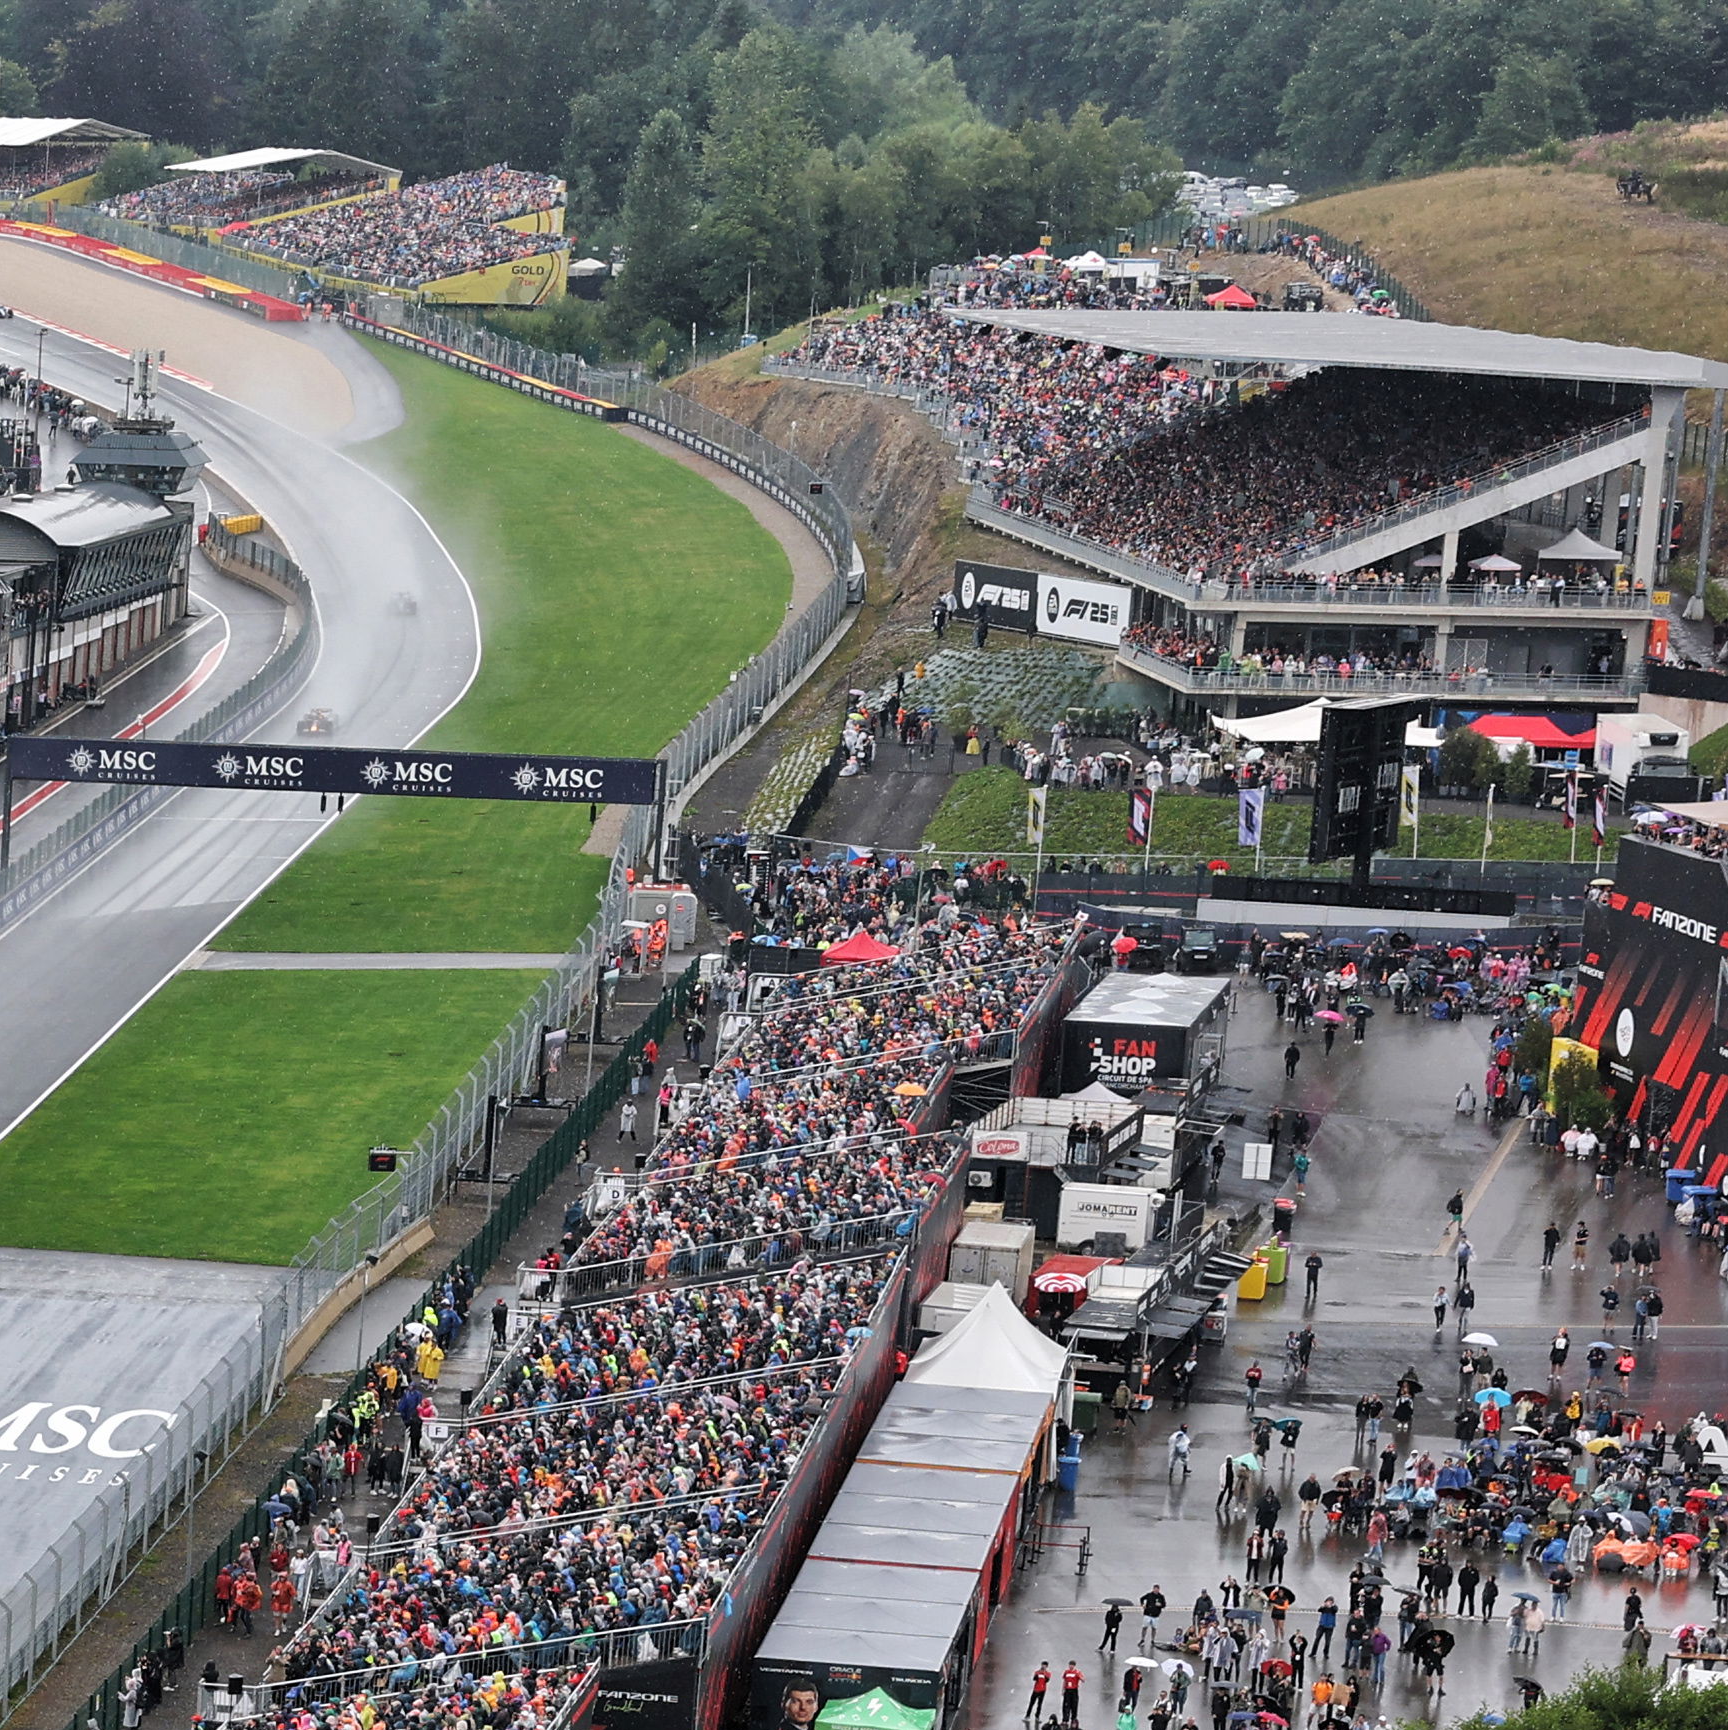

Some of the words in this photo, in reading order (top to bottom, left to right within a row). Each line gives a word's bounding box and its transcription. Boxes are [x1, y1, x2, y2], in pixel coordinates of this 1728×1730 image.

[511, 265, 544, 276] GOLD
[1001, 587, 1020, 609] 25
[1090, 602, 1109, 624] 25
[98, 750, 156, 771] MSC
[246, 755, 303, 776] MSC
[98, 772, 156, 781] CRUISES
[394, 762, 453, 782] MSC
[544, 767, 603, 789] MSC
[245, 778, 303, 788] CRUISES
[393, 783, 452, 792] CRUISES
[542, 790, 602, 800] CRUISES
[1651, 906, 1717, 945] FANZONE
[1114, 1040, 1157, 1058] FAN
[1099, 1056, 1156, 1076] SHOP
[1097, 1073, 1126, 1083] CIRCUIT
[1127, 1075, 1137, 1084] DE
[1138, 1075, 1153, 1085] SPA
[829, 1666, 862, 1674] ORACLE
[597, 1689, 679, 1704] FANZONE
